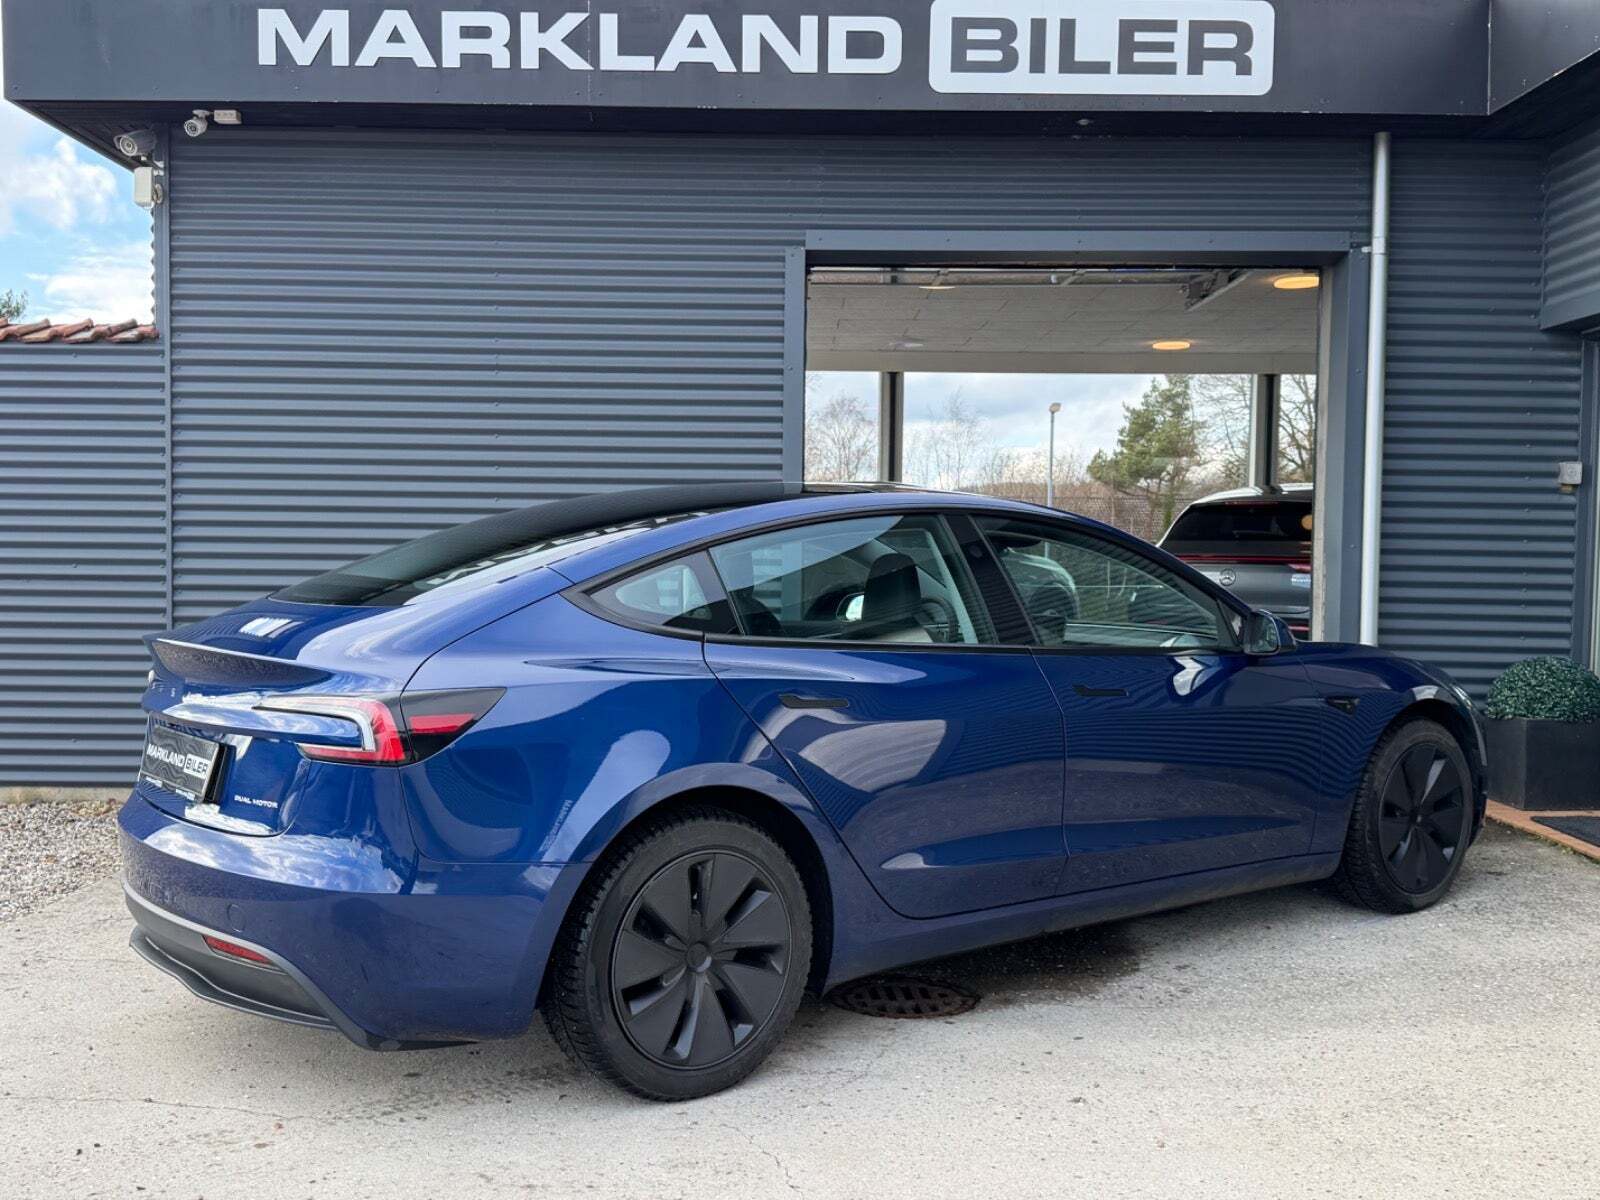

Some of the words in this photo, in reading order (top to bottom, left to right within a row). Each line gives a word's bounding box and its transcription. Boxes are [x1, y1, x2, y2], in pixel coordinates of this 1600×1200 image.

[257, 8, 902, 74] MARKLAND
[950, 17, 1253, 75] BILER
[146, 743, 186, 767] MARKLAND
[185, 758, 208, 774] BILER
[234, 794, 251, 804] DUAL
[252, 799, 278, 808] MOTOR
